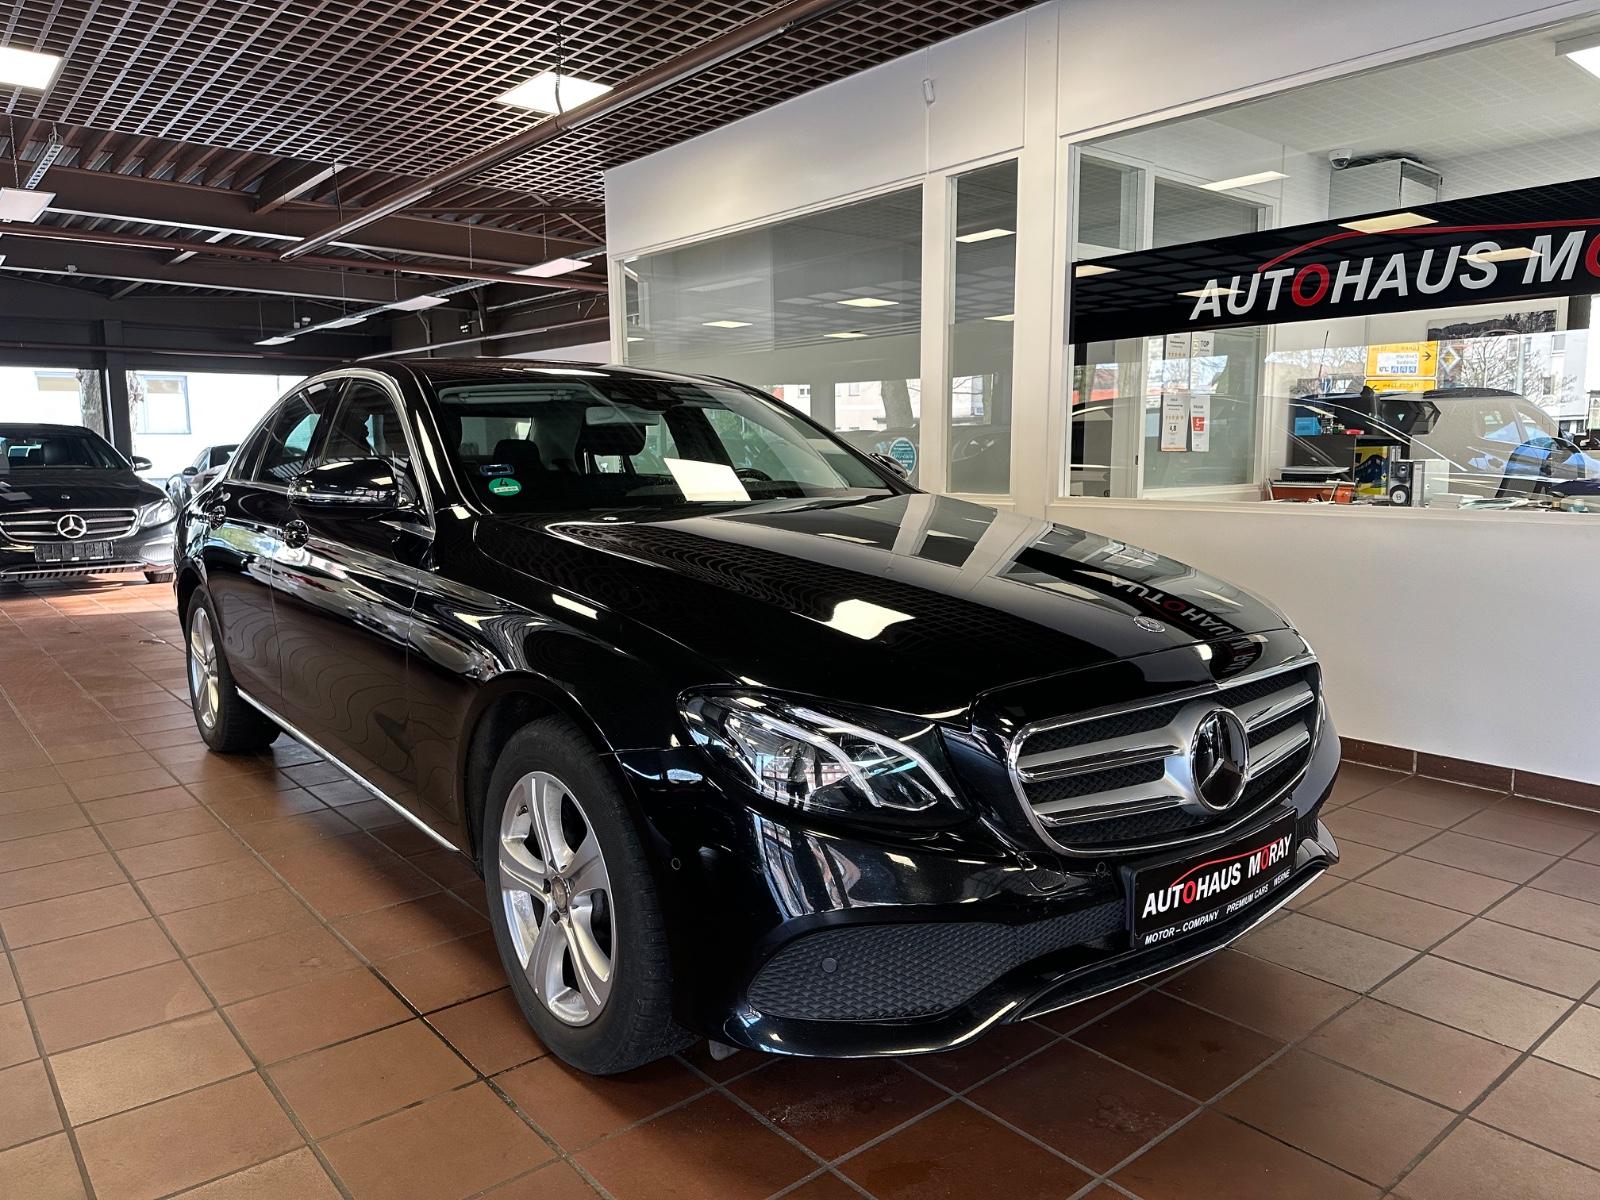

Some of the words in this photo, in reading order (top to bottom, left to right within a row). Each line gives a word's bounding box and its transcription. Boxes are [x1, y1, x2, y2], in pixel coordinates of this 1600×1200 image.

[1189, 241, 1502, 320] AUTOHAUS
[500, 478, 509, 487] 4
[1142, 862, 1241, 919] AUTOHAUS
[1248, 833, 1292, 878] MORAY
[1144, 927, 1175, 946] MOTOR
[1183, 909, 1220, 932] COMPANY
[1226, 894, 1253, 914] PREMIUM
[1254, 883, 1269, 900] CARS
[1273, 868, 1291, 887] WERNE
